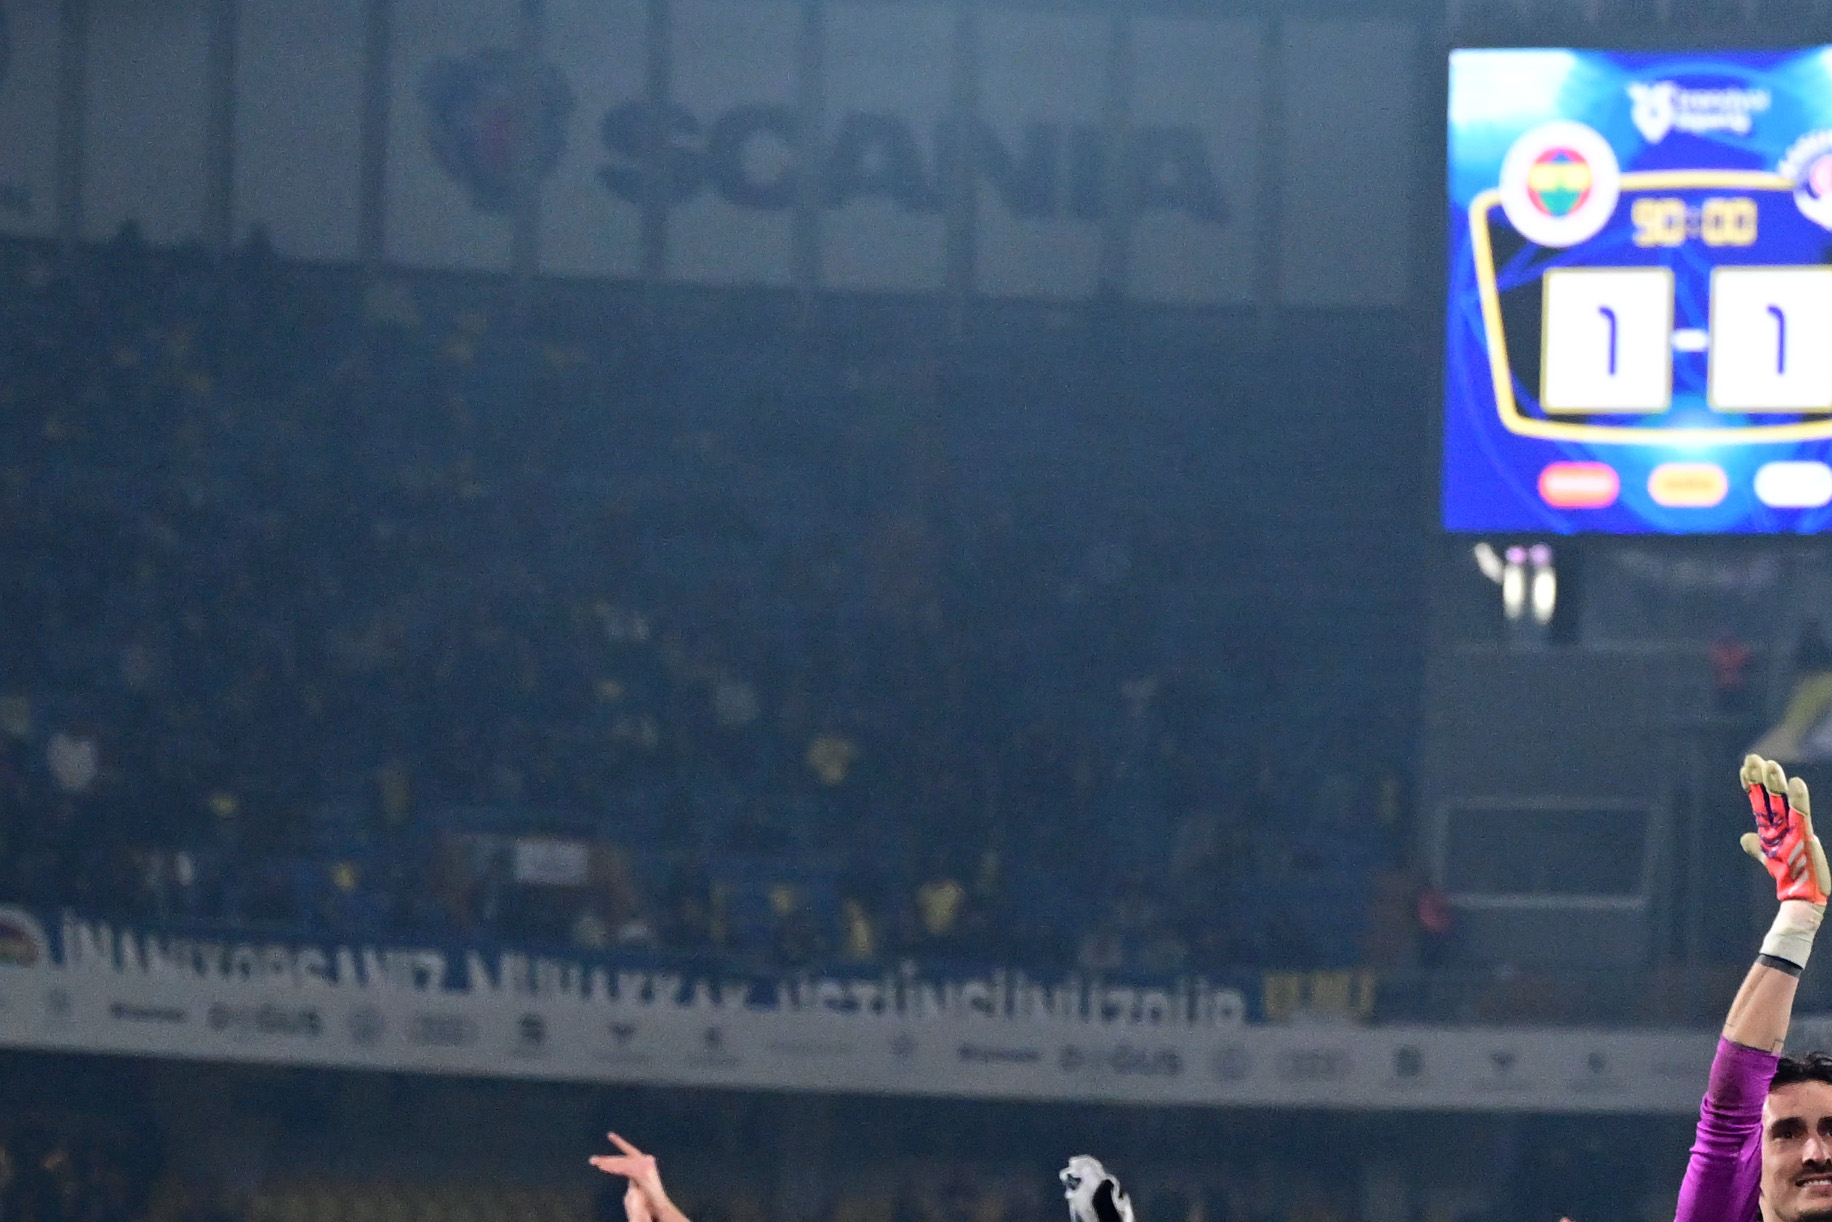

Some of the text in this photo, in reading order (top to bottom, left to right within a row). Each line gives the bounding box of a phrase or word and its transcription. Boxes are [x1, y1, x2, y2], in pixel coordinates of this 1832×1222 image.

[595, 100, 1231, 225] SCANIA
[1598, 304, 1786, 376] 1 1
